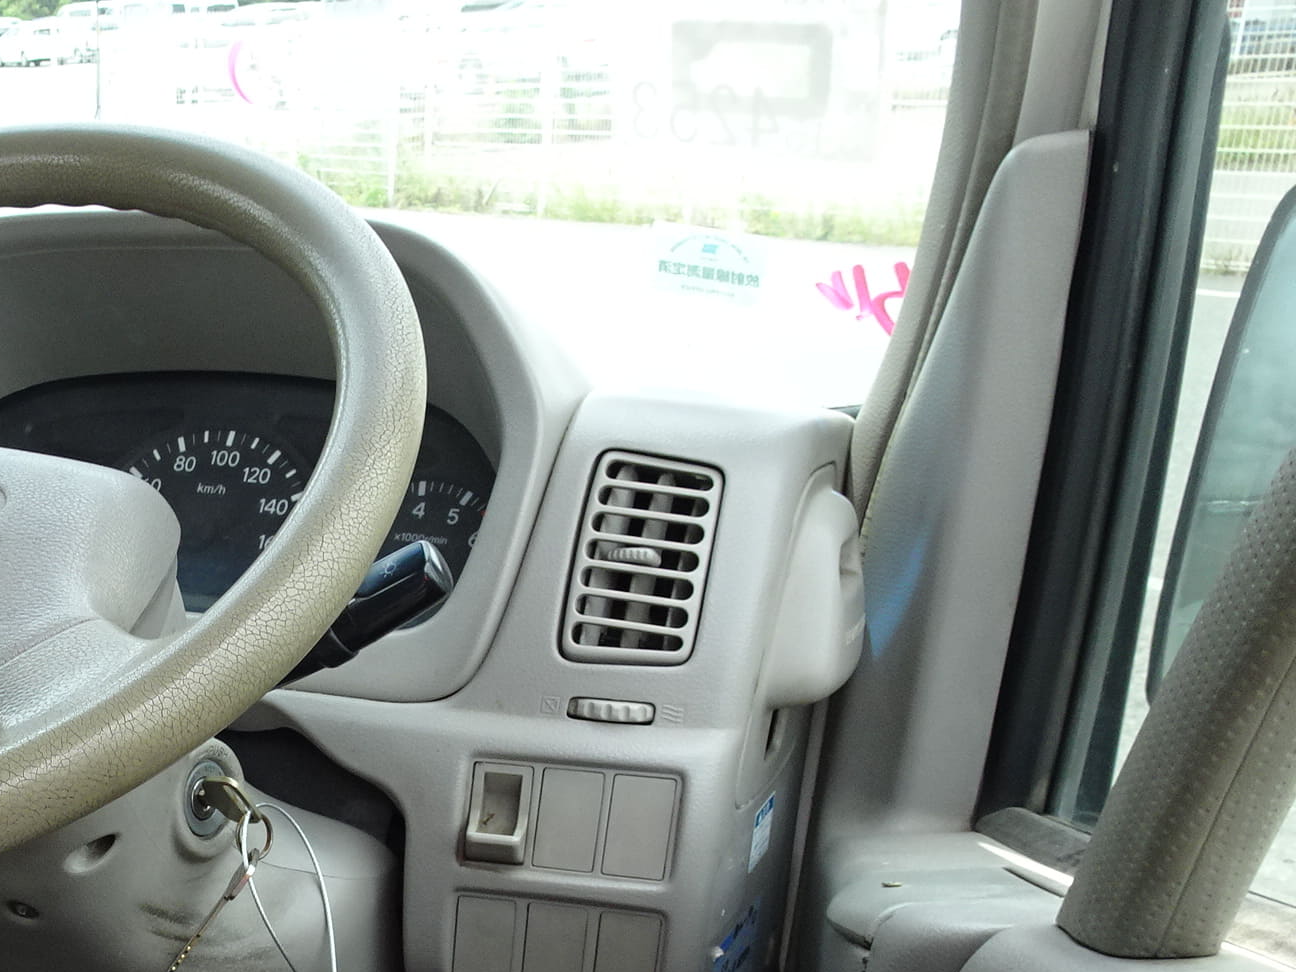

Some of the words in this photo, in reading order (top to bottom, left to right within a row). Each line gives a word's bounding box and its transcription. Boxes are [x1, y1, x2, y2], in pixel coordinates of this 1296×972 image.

[173, 455, 197, 472] 80
[210, 450, 240, 467] 100
[242, 467, 271, 484] 120
[196, 482, 226, 495] km/h
[258, 498, 289, 516] 140
[412, 502, 426, 520] 4
[446, 508, 461, 525] 5
